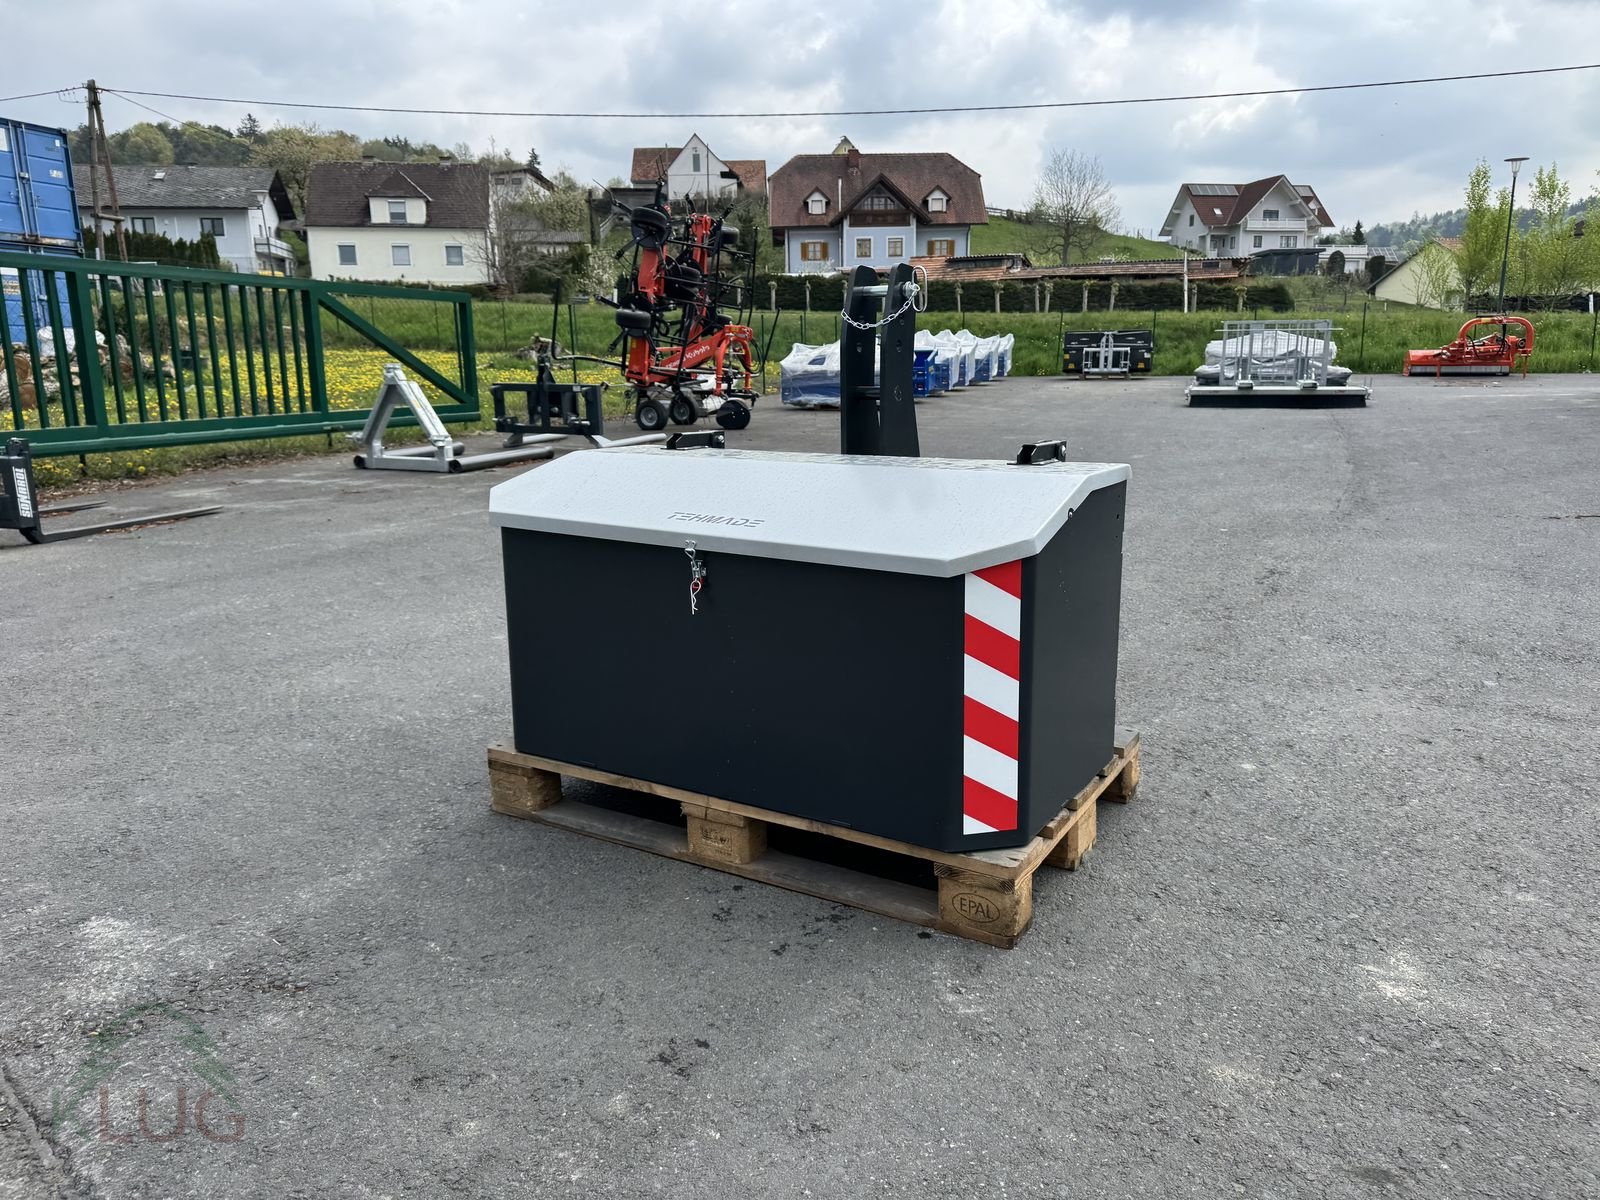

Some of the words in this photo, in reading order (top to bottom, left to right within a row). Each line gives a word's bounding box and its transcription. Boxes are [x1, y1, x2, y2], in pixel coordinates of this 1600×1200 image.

[13, 466, 33, 518] SONAROL
[667, 511, 765, 528] TEHMADE
[960, 897, 994, 920] EPAL
